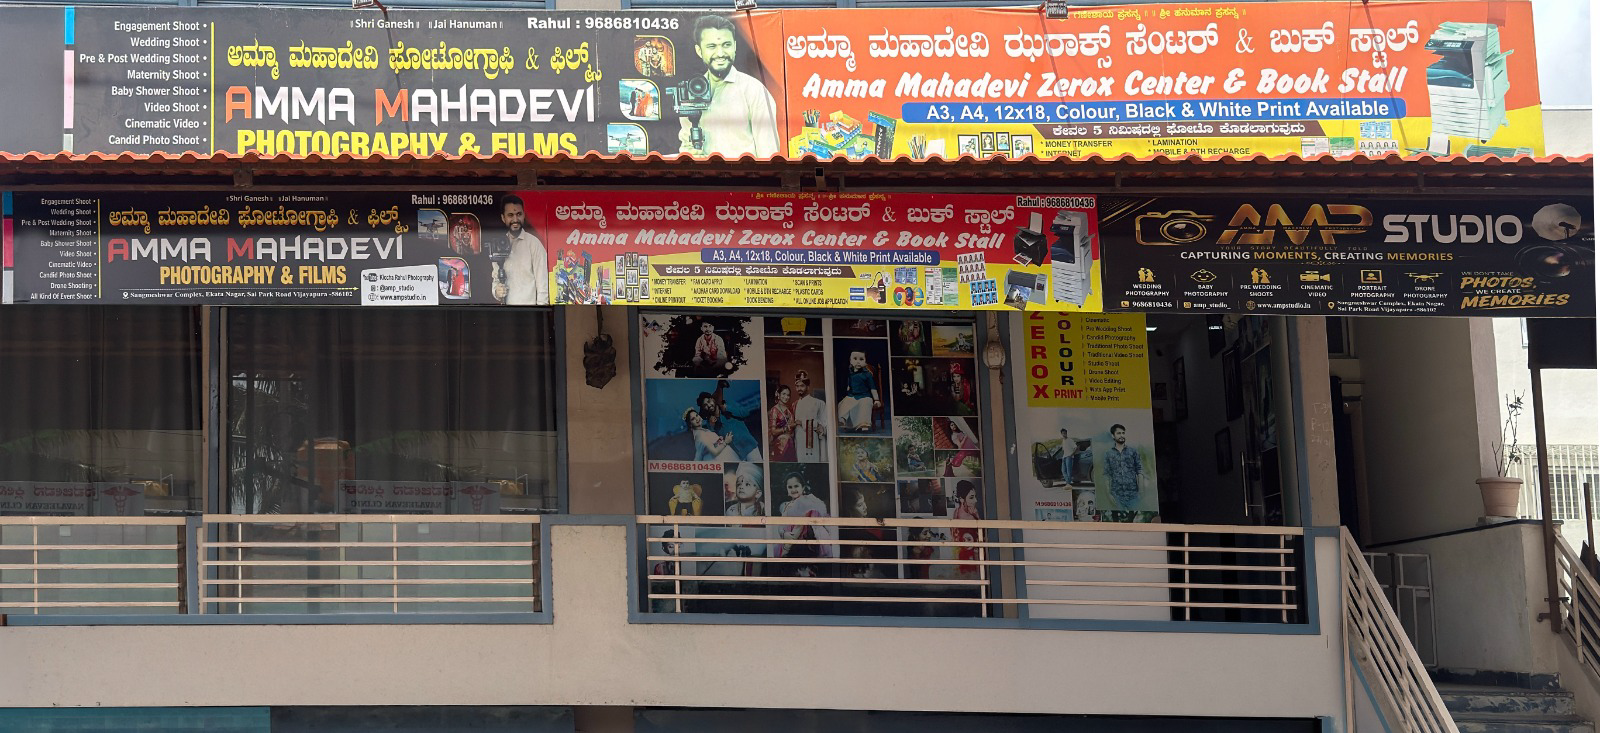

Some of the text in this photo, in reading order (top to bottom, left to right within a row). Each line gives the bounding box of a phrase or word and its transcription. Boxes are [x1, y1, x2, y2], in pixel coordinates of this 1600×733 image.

[114, 21, 200, 33] Engagement Shoot
[355, 19, 414, 28] Shri Ganesh
[434, 19, 498, 29] Jai Hanuman
[527, 17, 679, 30] Rahul 9686810436
[131, 37, 200, 48] Wedding Shoot
[787, 20, 1419, 72] ಅಮ್ಮಾ ಮಹಾದೇವಿ ಝರಾಕ್ಸ್ ಸೆಂಟರ್ & ಬುಕ್ ಸ್ಟಾಲ್
[79, 53, 200, 64] Pre & Post Wedding Shoot
[227, 37, 280, 80] ಅಮ್ಮಾ
[289, 39, 378, 69] ಮಹಾದೇವಿ
[388, 41, 515, 80] ಫೋಟೋಗ್ರಾಫಿ
[526, 47, 540, 70] &
[127, 69, 200, 81] Maternity Shoot
[802, 66, 1408, 99] Amma Mahadevi Zerox Center & Book Stall
[111, 86, 200, 97] Baby Shower Shoot
[144, 102, 200, 112] Video Shoot
[226, 83, 595, 126] AMMA MAHADEVI
[927, 100, 1389, 122] A3, A4, 12x18, Colour, Black & White Print Available
[125, 118, 200, 128] Cinematic Video
[1052, 125, 1088, 136] ಕೇವಲ
[1092, 126, 1102, 135] 5
[1108, 124, 1162, 137] ನಿಮಿಷದಲ್ಲಿ
[1219, 121, 1305, 136] ಕೊಡಲಾಗುವುದು
[108, 134, 200, 145] Candid Photo Shoot
[238, 130, 578, 156] PHOTOGRAPHY & FILMS
[1045, 140, 1071, 148] MONEY
[1152, 138, 1198, 146] LAMINATION
[41, 198, 74, 206] Engagement
[411, 194, 493, 205] Rahul 9686810436
[1016, 196, 1095, 209] Rahul 9686810436
[109, 206, 151, 235] ಅಮ್ಮಾ
[158, 204, 230, 226] ಮಹಾದೇವಿ
[238, 205, 339, 233] ಫೋಟೋಗ್ರಾಫಿ
[347, 208, 359, 226] &
[555, 200, 1015, 235] ಅಮ್ಮಾ ಮಹಾದೇವಿ ಝರಾಕ್ಸ್ ಸೆಂಟರ್ & ಬುಕ್ ಸ್ಟಾಲ್
[1215, 203, 1374, 245] AMP
[1382, 214, 1524, 245] STUDIO
[566, 228, 1006, 249] Amma Mahadevi Zerox Center & Book Stall
[107, 234, 403, 263] AMMA MAHADEVI
[713, 249, 932, 264] A3, A4, 12x18, Colour, Black & White Print Available
[1180, 251, 1454, 261] CAPTURING MOMENTS, CREATING MEMORIES
[160, 265, 275, 285] PHOTOGRAPHY
[280, 265, 293, 285] &
[299, 265, 347, 285] FILMS
[1460, 276, 1537, 290] PHOTOS,
[1460, 293, 1571, 309] MEMORIES
[1054, 389, 1083, 399] PRINT
[649, 462, 722, 471] M.9686810436
